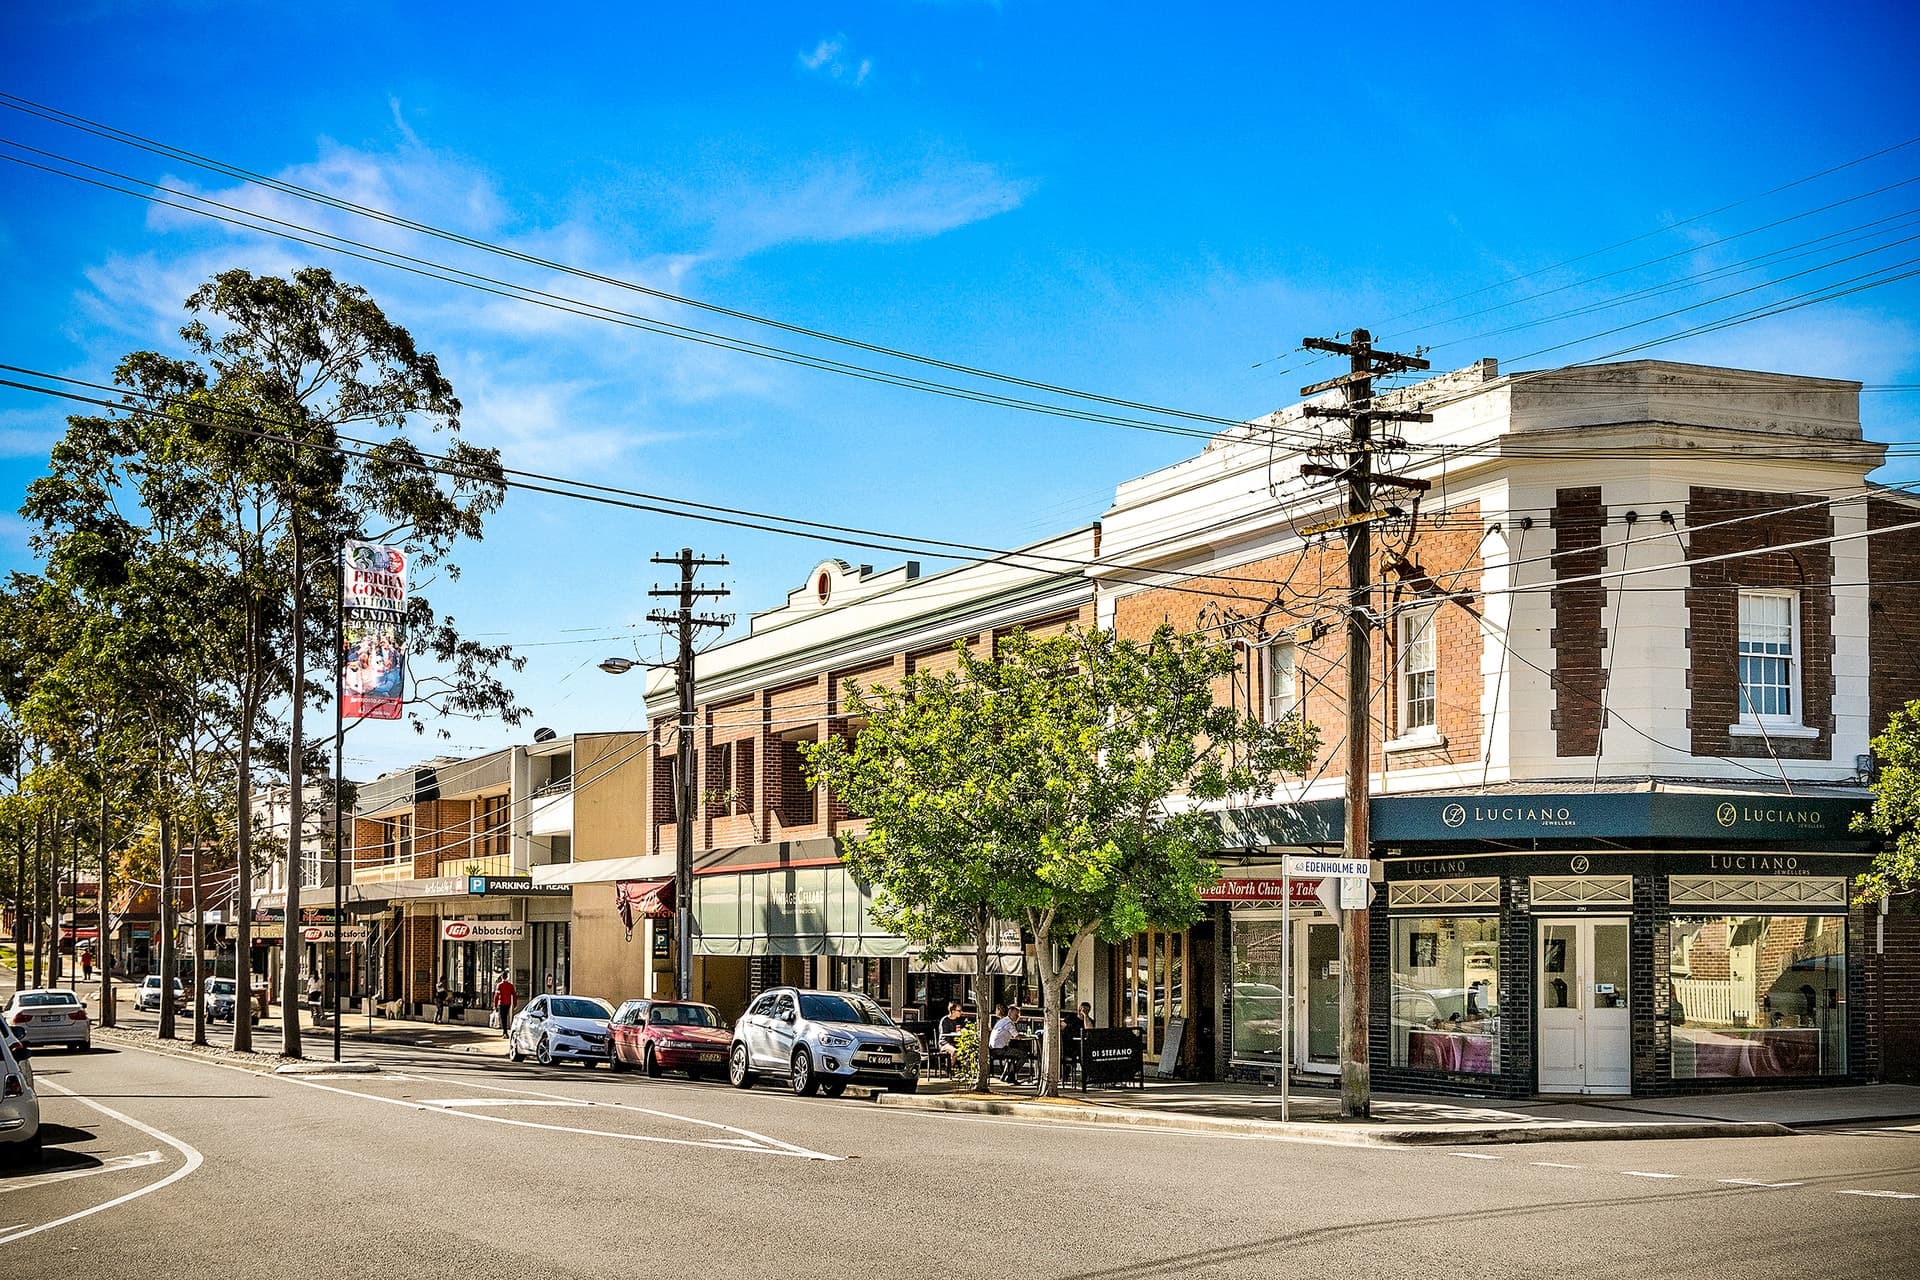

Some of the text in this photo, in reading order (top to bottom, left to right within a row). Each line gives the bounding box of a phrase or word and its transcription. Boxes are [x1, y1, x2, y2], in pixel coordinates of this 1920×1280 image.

[354, 570, 402, 588] FERRA
[352, 584, 403, 600] GOSTO
[351, 608, 402, 623] SUNDAY
[1475, 807, 1570, 821] LUCIANO
[1744, 808, 1821, 823] LUCIANO
[1305, 862, 1368, 874] EDENHOLME RD
[1406, 860, 1465, 874] LUCIANO
[1710, 855, 1797, 870] LUCIANO
[490, 881, 530, 890] PARKING
[1227, 881, 1255, 895] North
[1258, 881, 1294, 895] Chinee
[324, 929, 366, 938] Abotsford
[472, 925, 522, 935] Abbotsford
[1101, 1048, 1132, 1056] STEFANO
